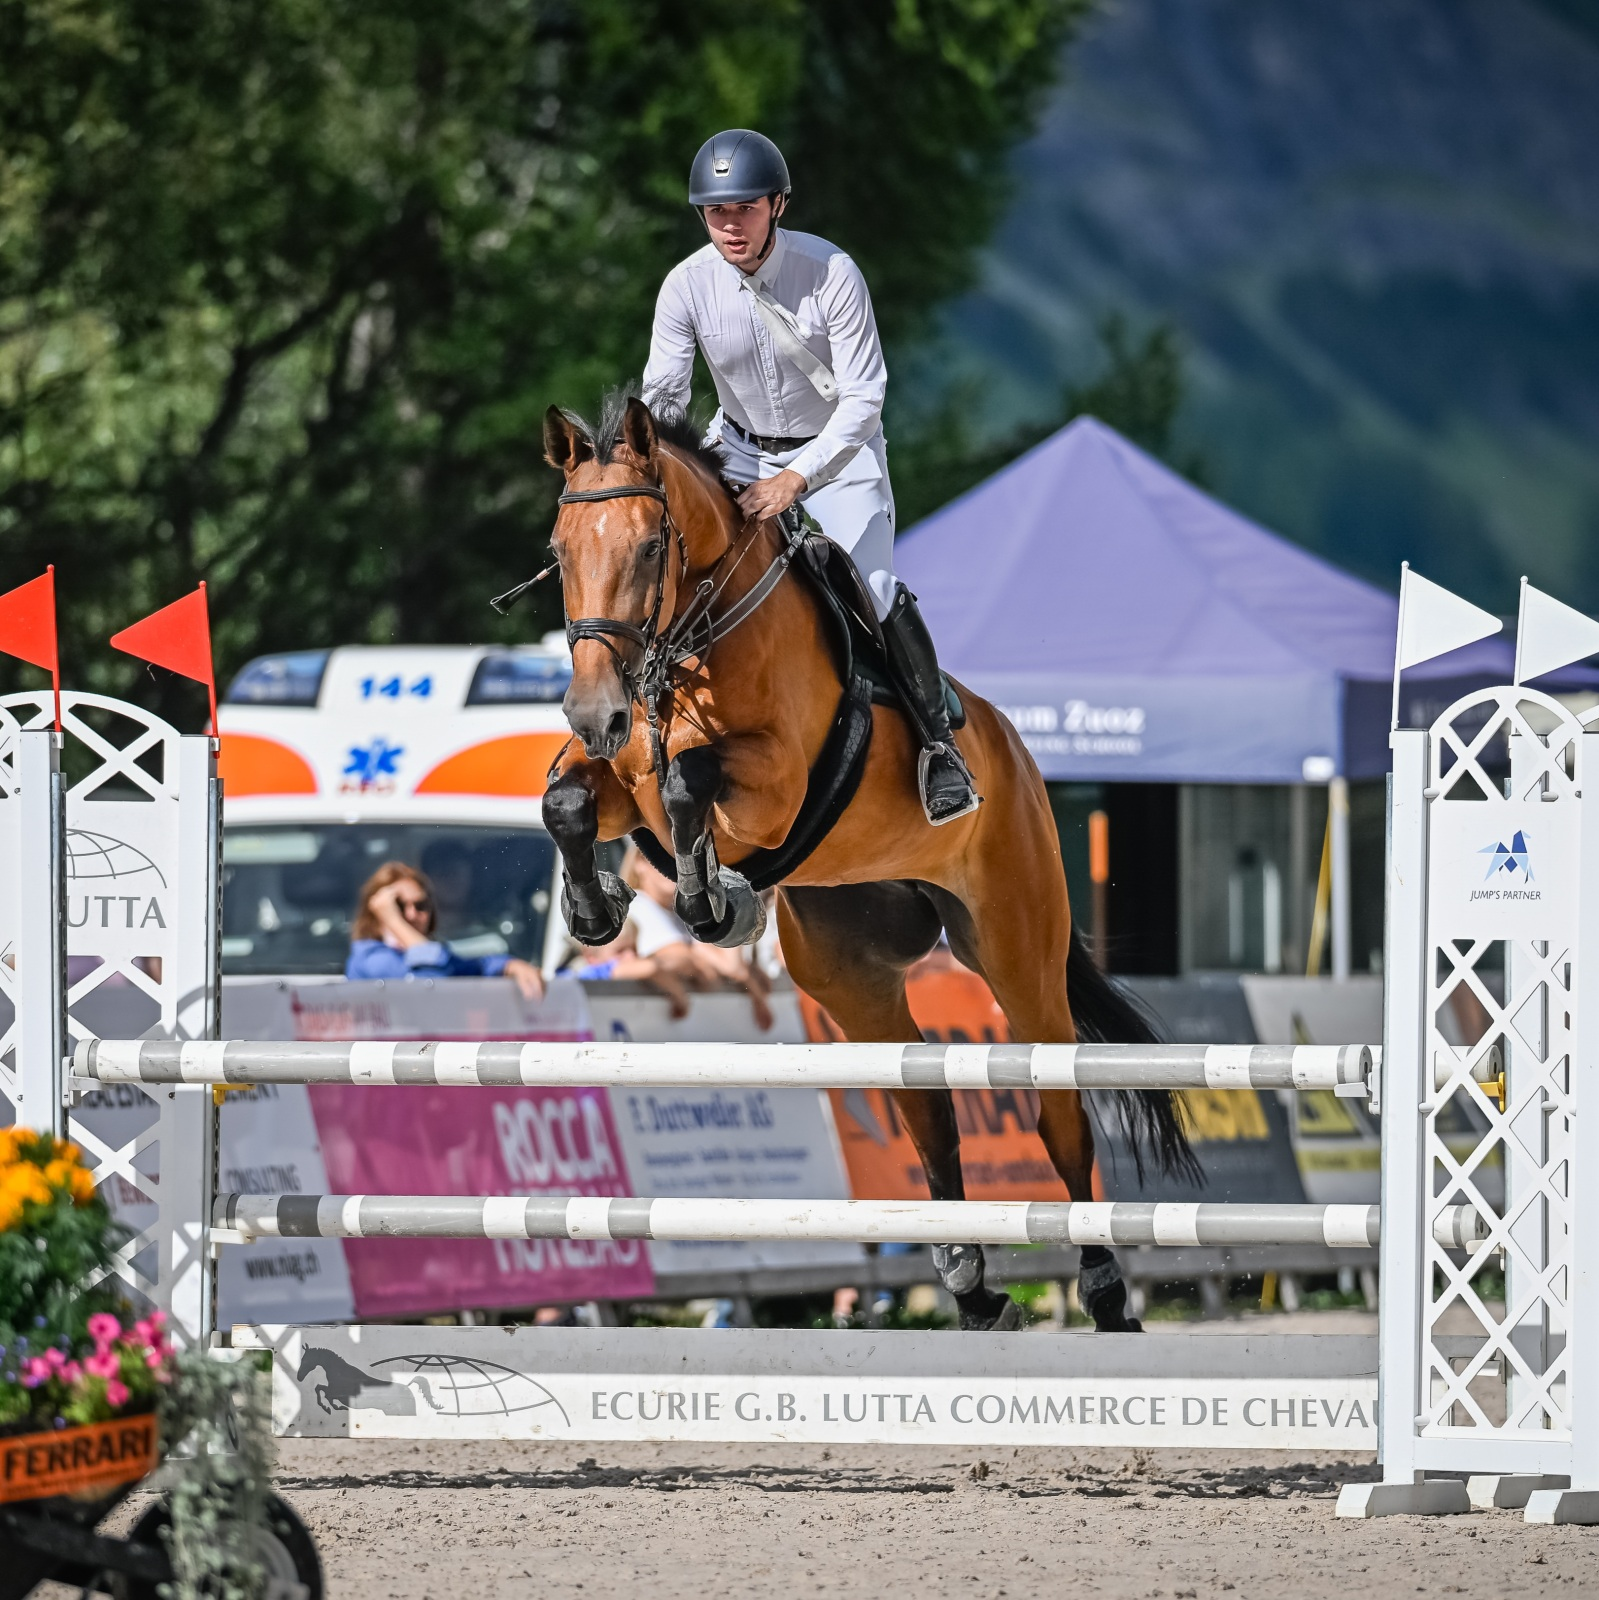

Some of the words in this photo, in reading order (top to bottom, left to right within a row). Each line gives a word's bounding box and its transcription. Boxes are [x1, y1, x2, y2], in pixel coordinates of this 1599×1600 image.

[359, 676, 433, 698] 144
[1063, 699, 1146, 735] Zuoz
[67, 895, 167, 929] UTTA
[1469, 890, 1501, 902] JUMP'S
[1502, 890, 1541, 900] PARTNER
[492, 1096, 618, 1184] ROCCA
[591, 1391, 720, 1421] ECURIE
[734, 1392, 807, 1422] G.B.
[823, 1393, 937, 1423] LUTTA
[950, 1394, 1166, 1425] COMMERCE
[1182, 1397, 1228, 1426] DE
[5, 1425, 152, 1481] FERRARI
